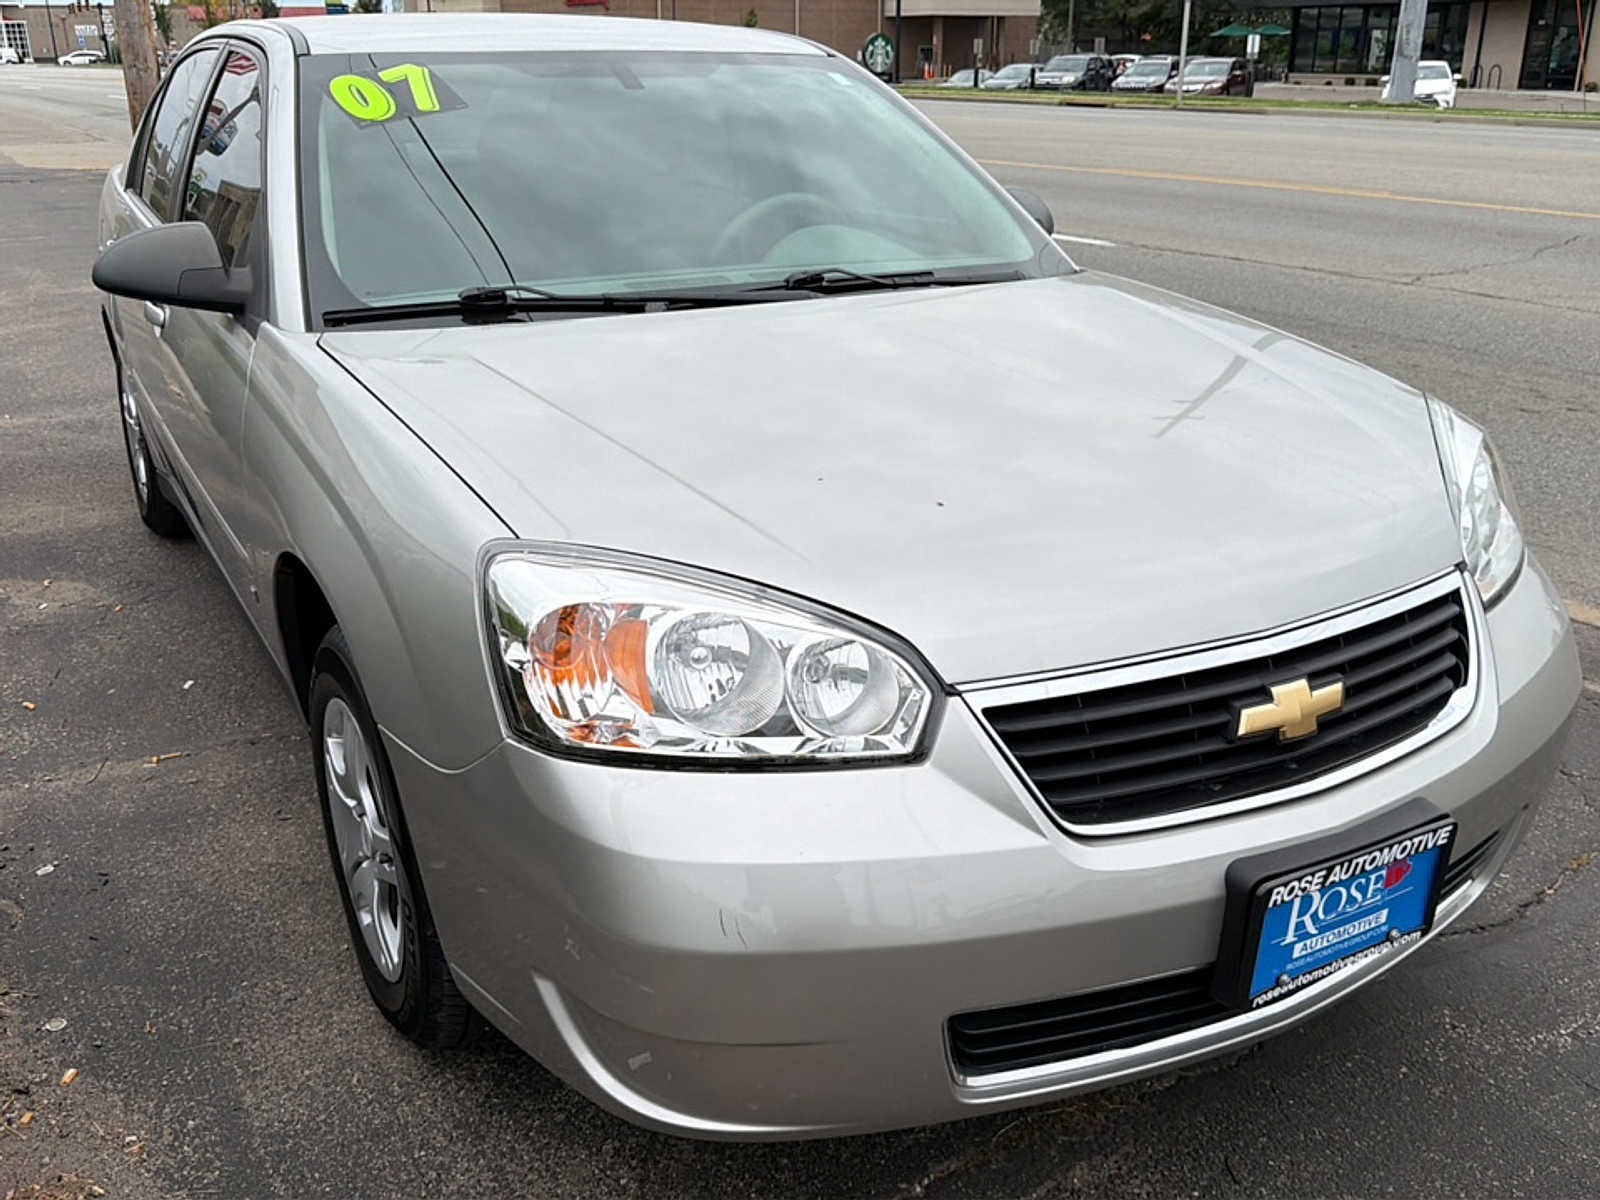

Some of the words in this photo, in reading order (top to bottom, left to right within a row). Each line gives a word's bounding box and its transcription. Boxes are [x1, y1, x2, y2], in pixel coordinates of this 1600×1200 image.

[329, 64, 440, 121] 07
[1268, 870, 1327, 908] ROSE
[1325, 826, 1453, 887] AUTOMOTIVE
[1279, 867, 1388, 946] ROSE
[1298, 914, 1384, 954] AUTOMOTIVE
